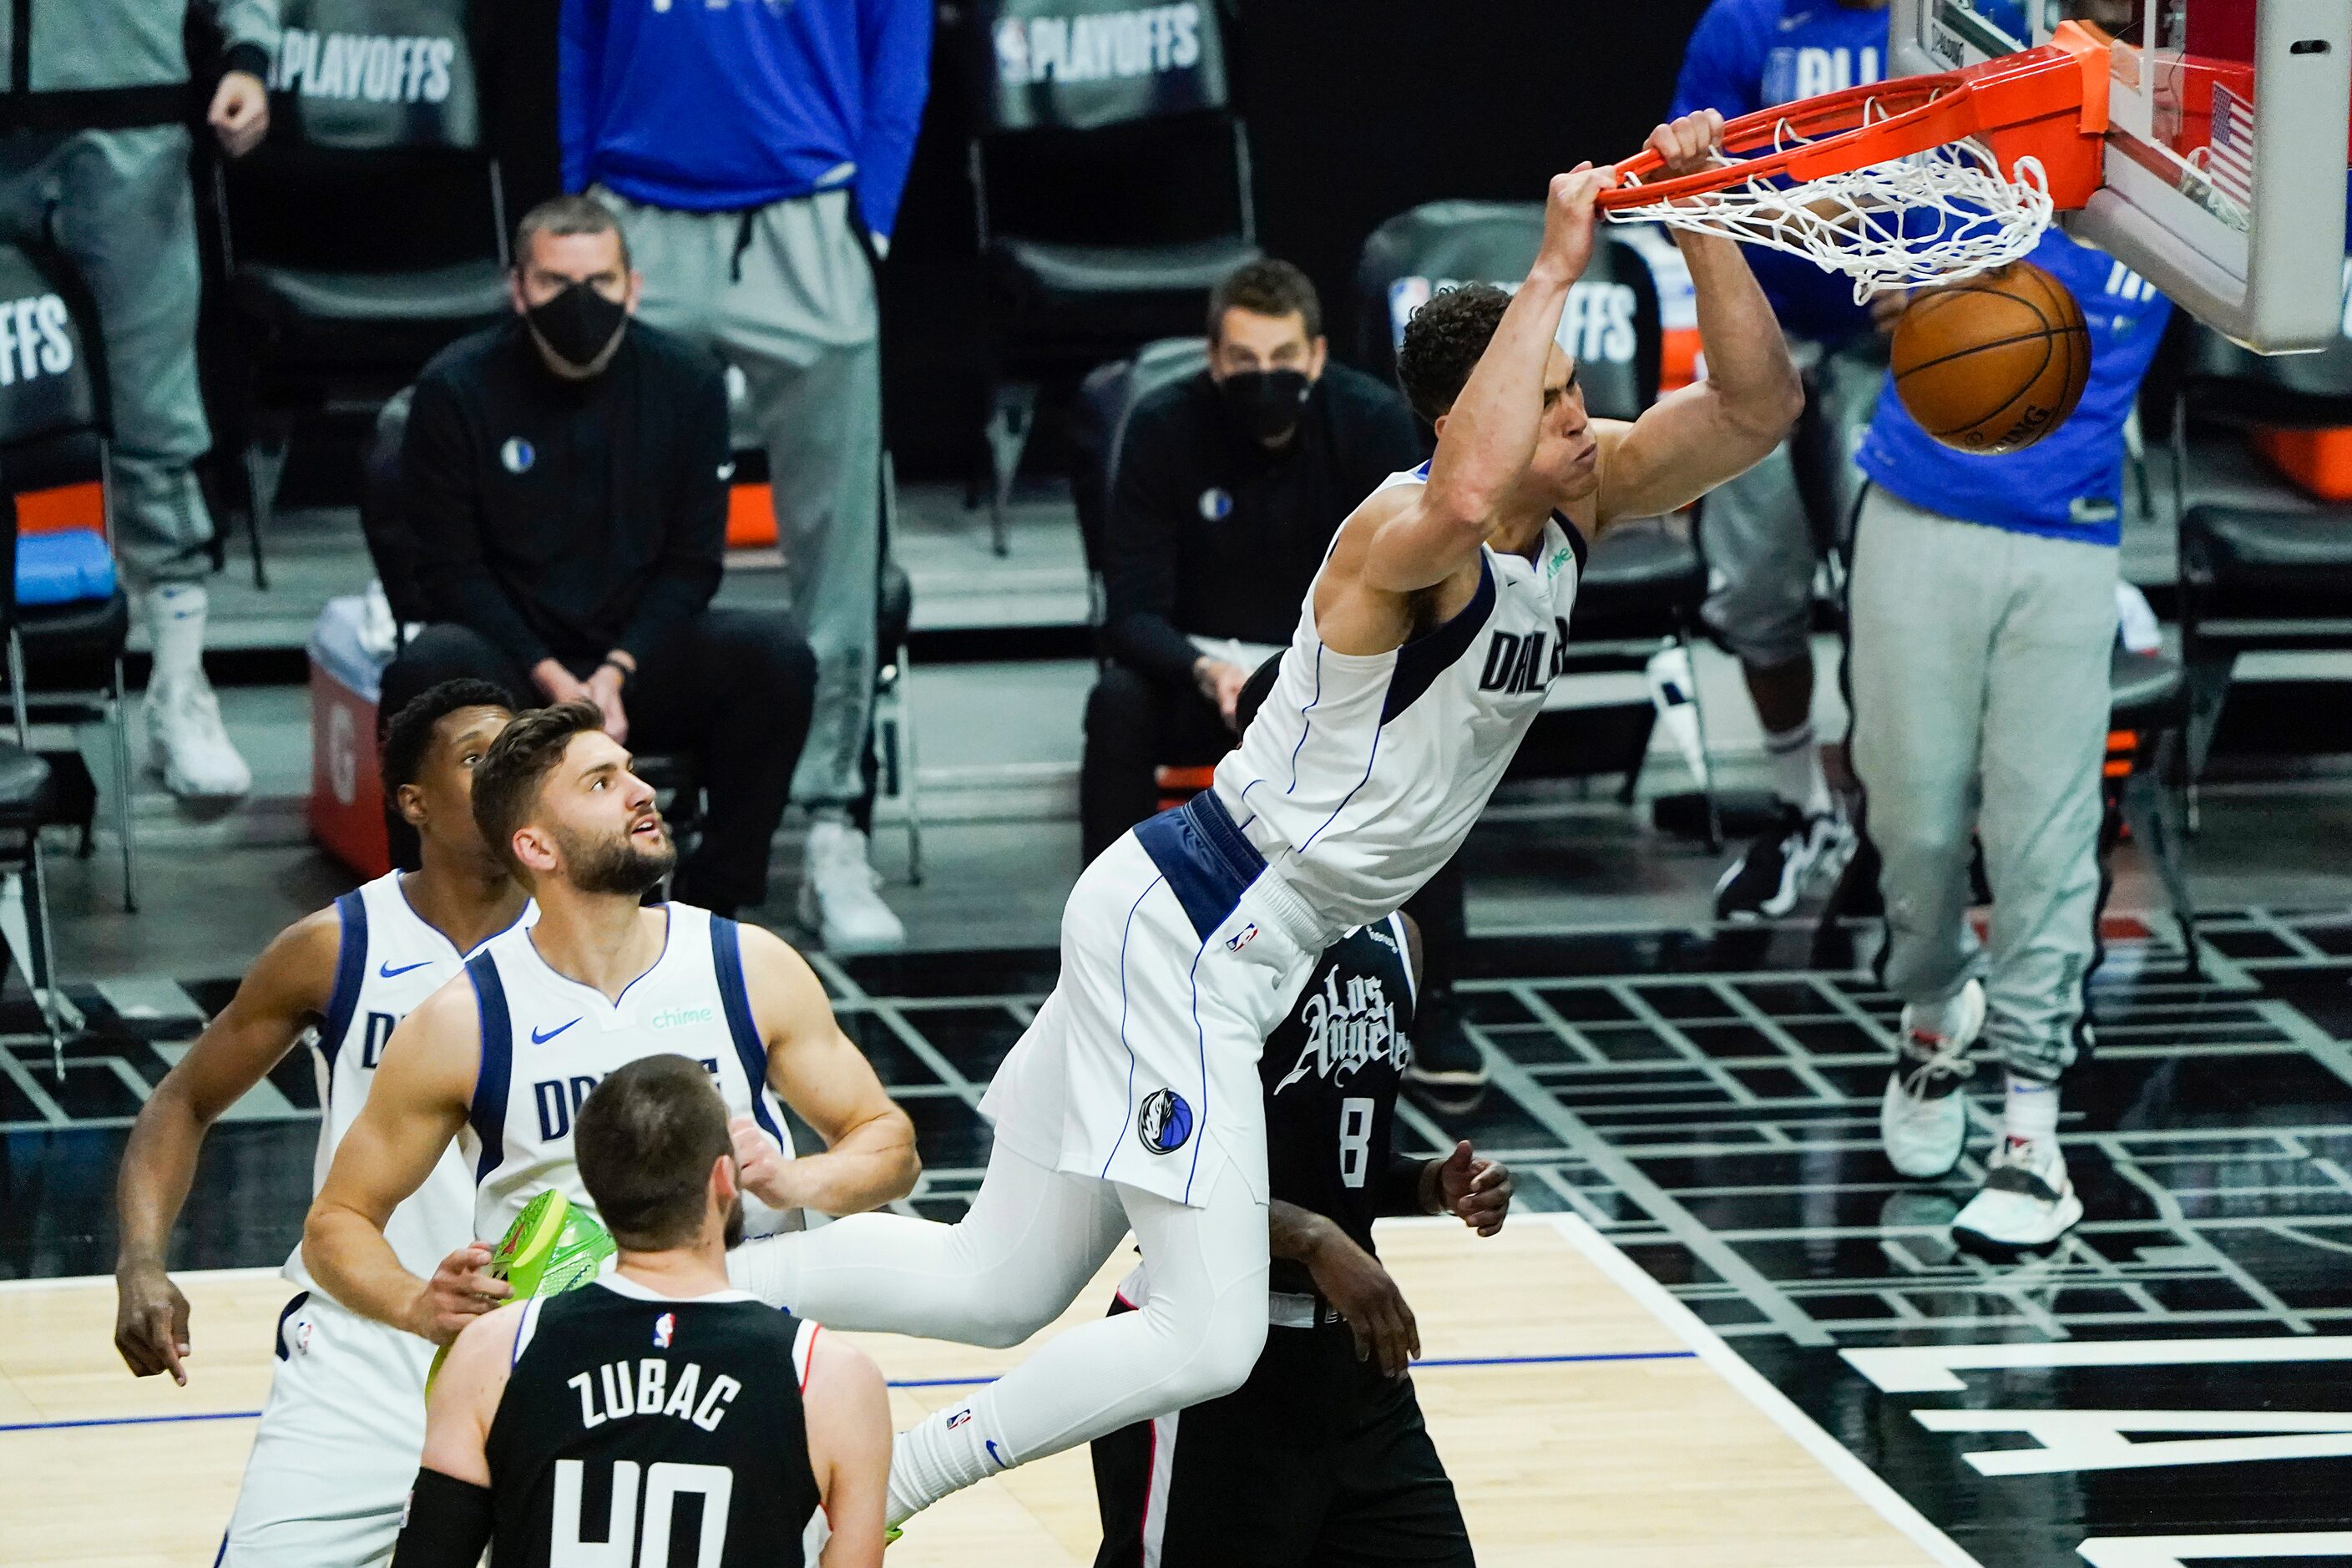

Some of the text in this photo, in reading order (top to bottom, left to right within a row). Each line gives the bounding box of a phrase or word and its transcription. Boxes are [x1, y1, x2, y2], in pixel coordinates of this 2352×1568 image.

[279, 27, 454, 104] PLAYOFFS
[1029, 3, 1199, 82] PLAYOFFS
[652, 1007, 713, 1029] chime
[1324, 964, 1386, 1021] Los
[1273, 1002, 1411, 1095] Angele
[1339, 1097, 1375, 1188] 8
[567, 1358, 742, 1432] ZUBAC
[549, 1459, 734, 1568] 40
